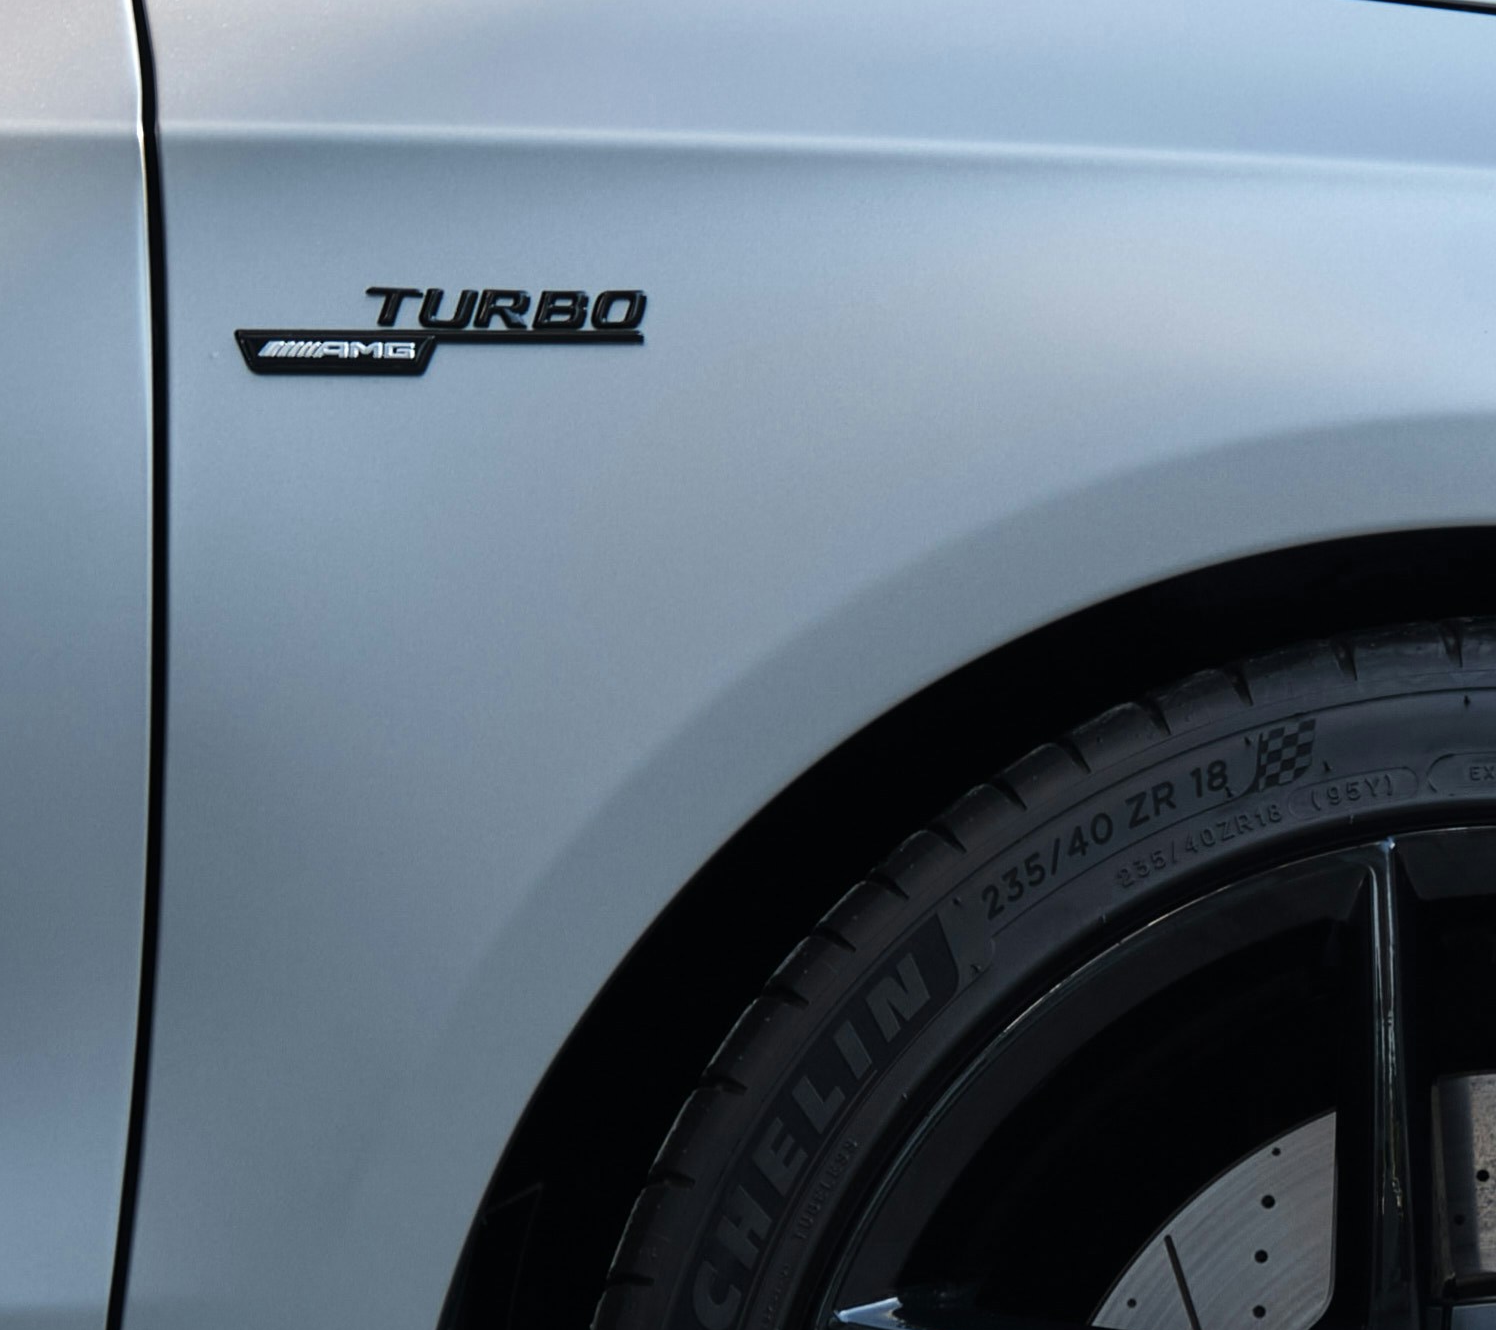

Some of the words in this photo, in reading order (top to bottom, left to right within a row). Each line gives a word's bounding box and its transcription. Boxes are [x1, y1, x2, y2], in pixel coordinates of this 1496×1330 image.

[366, 287, 647, 330] TURBO
[316, 340, 416, 360] AMG
[970, 809, 1120, 923] 235/40
[1117, 778, 1183, 830] ZR
[1185, 756, 1235, 800] 18
